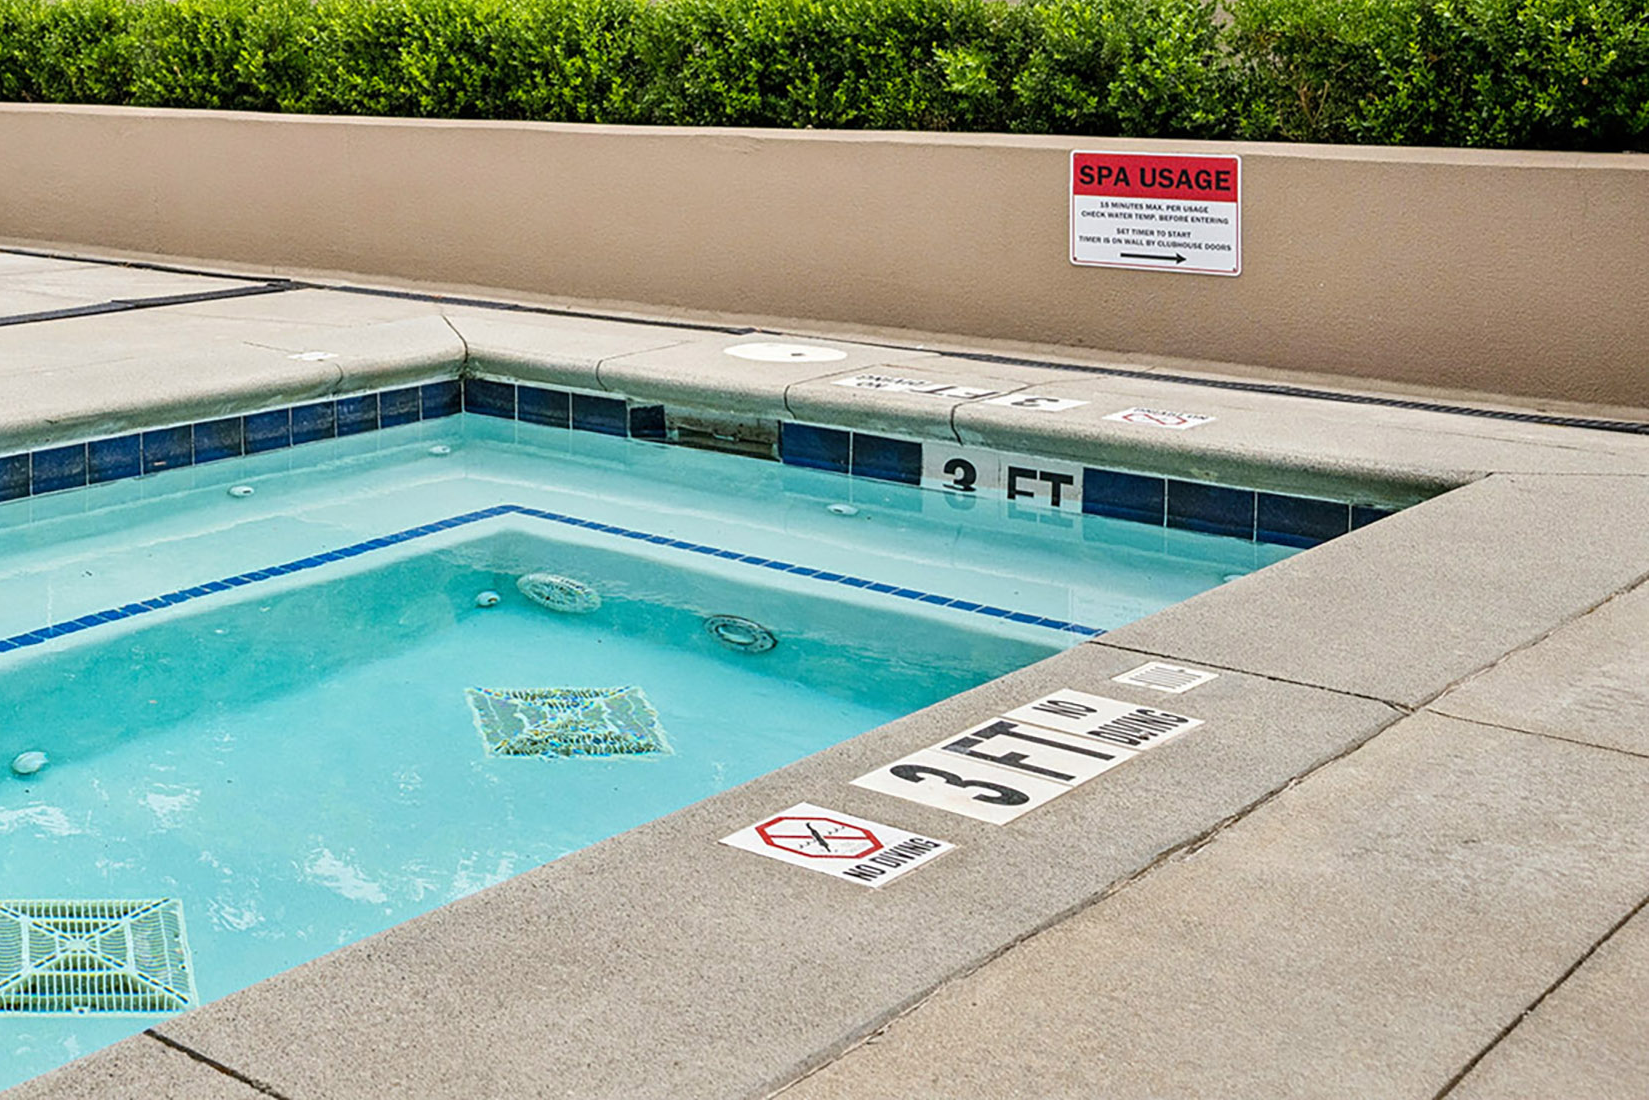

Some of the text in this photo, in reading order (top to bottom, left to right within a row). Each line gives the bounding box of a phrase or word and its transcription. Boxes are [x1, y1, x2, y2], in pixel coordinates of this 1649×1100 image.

[1079, 164, 1231, 191] SPA USAGE
[1081, 210, 1229, 225] CHECK WATER TEMP. BEFORE ENTERING
[1111, 202, 1143, 210] MINUTES
[1145, 203, 1164, 211] MAX.
[1183, 205, 1209, 213] USAGE
[1079, 235, 1101, 243] TIMER
[1124, 238, 1144, 246] WALL
[1157, 240, 1203, 250] CLUBHOUSE
[1205, 243, 1232, 251] DOORS
[1116, 227, 1130, 235] SET
[1132, 228, 1155, 236] TIMER
[942, 457, 1074, 508] 3 FT
[1032, 699, 1098, 721] NO
[1088, 708, 1190, 747] DIVING
[889, 720, 1118, 807] 3 FT
[842, 837, 942, 882] NO DIVING
